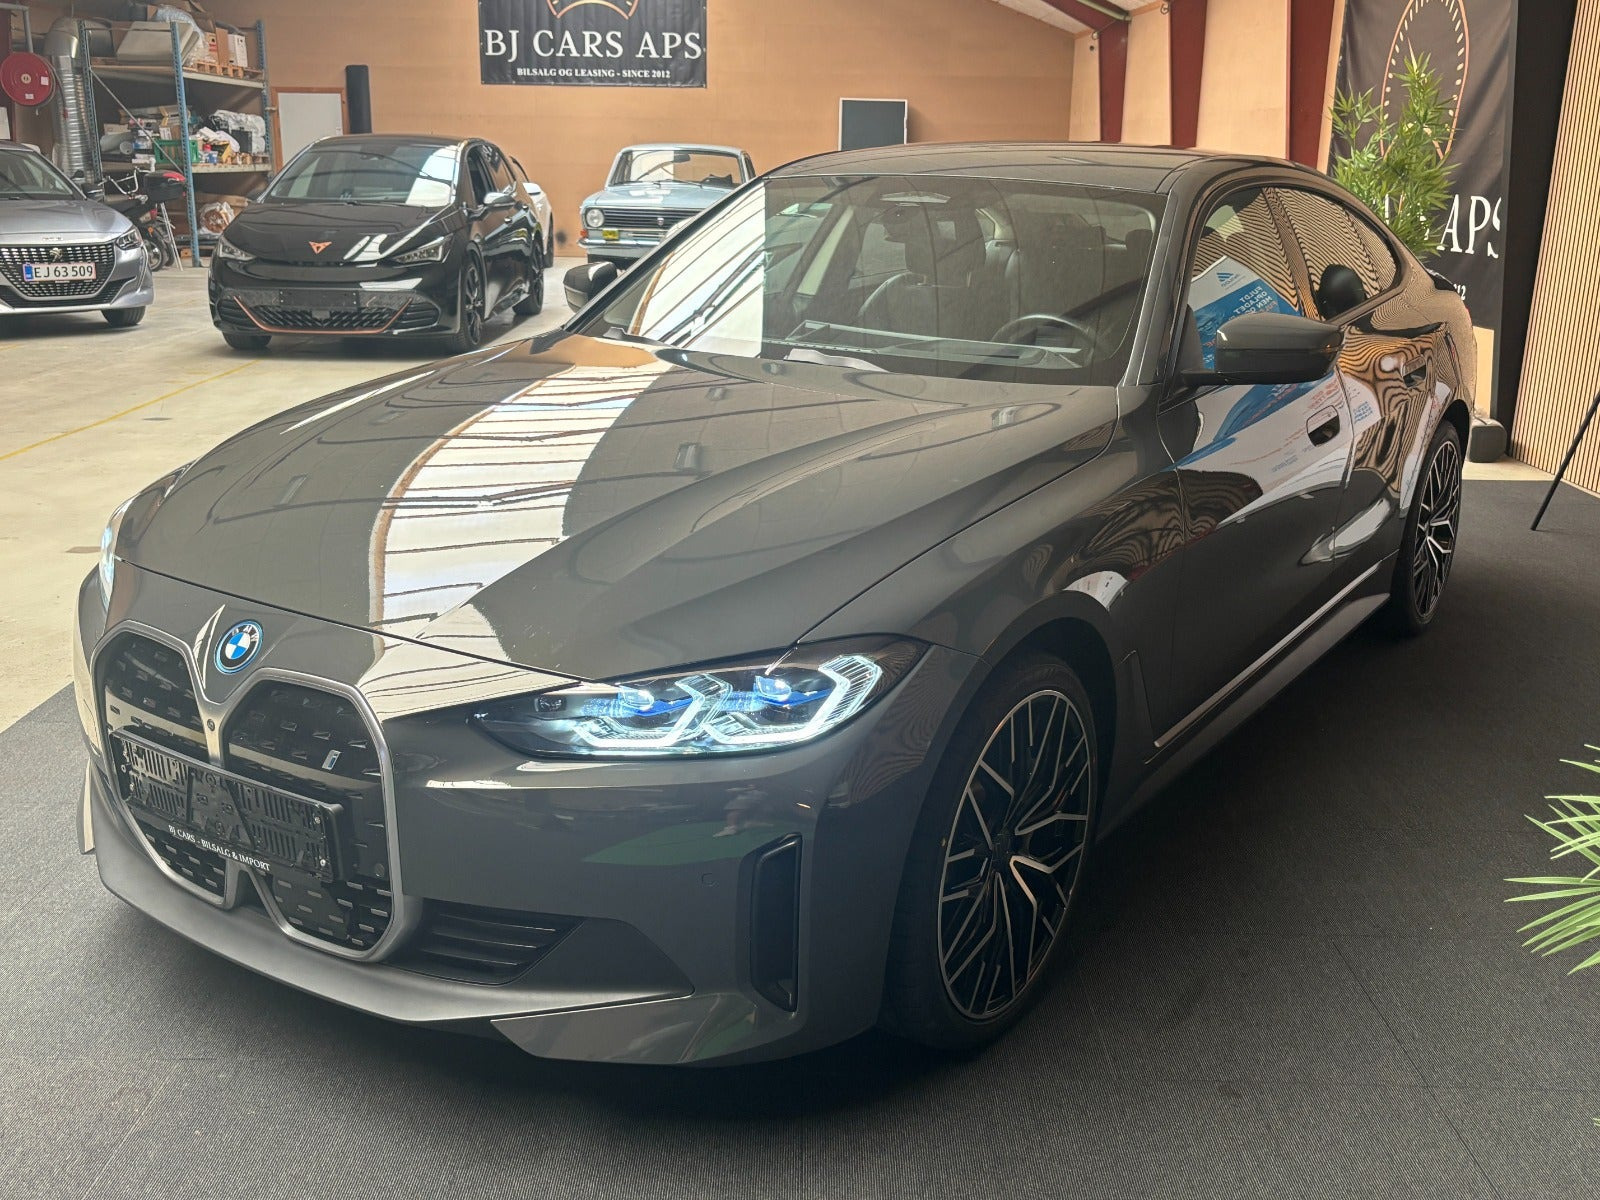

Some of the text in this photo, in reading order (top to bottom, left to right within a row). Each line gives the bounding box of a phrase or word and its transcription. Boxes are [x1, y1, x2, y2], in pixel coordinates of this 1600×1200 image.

[484, 29, 702, 62] BJ CARS APS
[516, 67, 557, 77] BILSALG
[558, 68, 573, 77] OG
[574, 68, 615, 78] LEASING
[622, 69, 650, 78] SINCE
[651, 69, 671, 79] 2012
[34, 265, 93, 278] EJ 63 509
[168, 824, 176, 836] BJ
[177, 829, 196, 843] CARS
[201, 838, 231, 858] BILSALG
[231, 851, 239, 861] &
[239, 853, 271, 871] IMPORT
